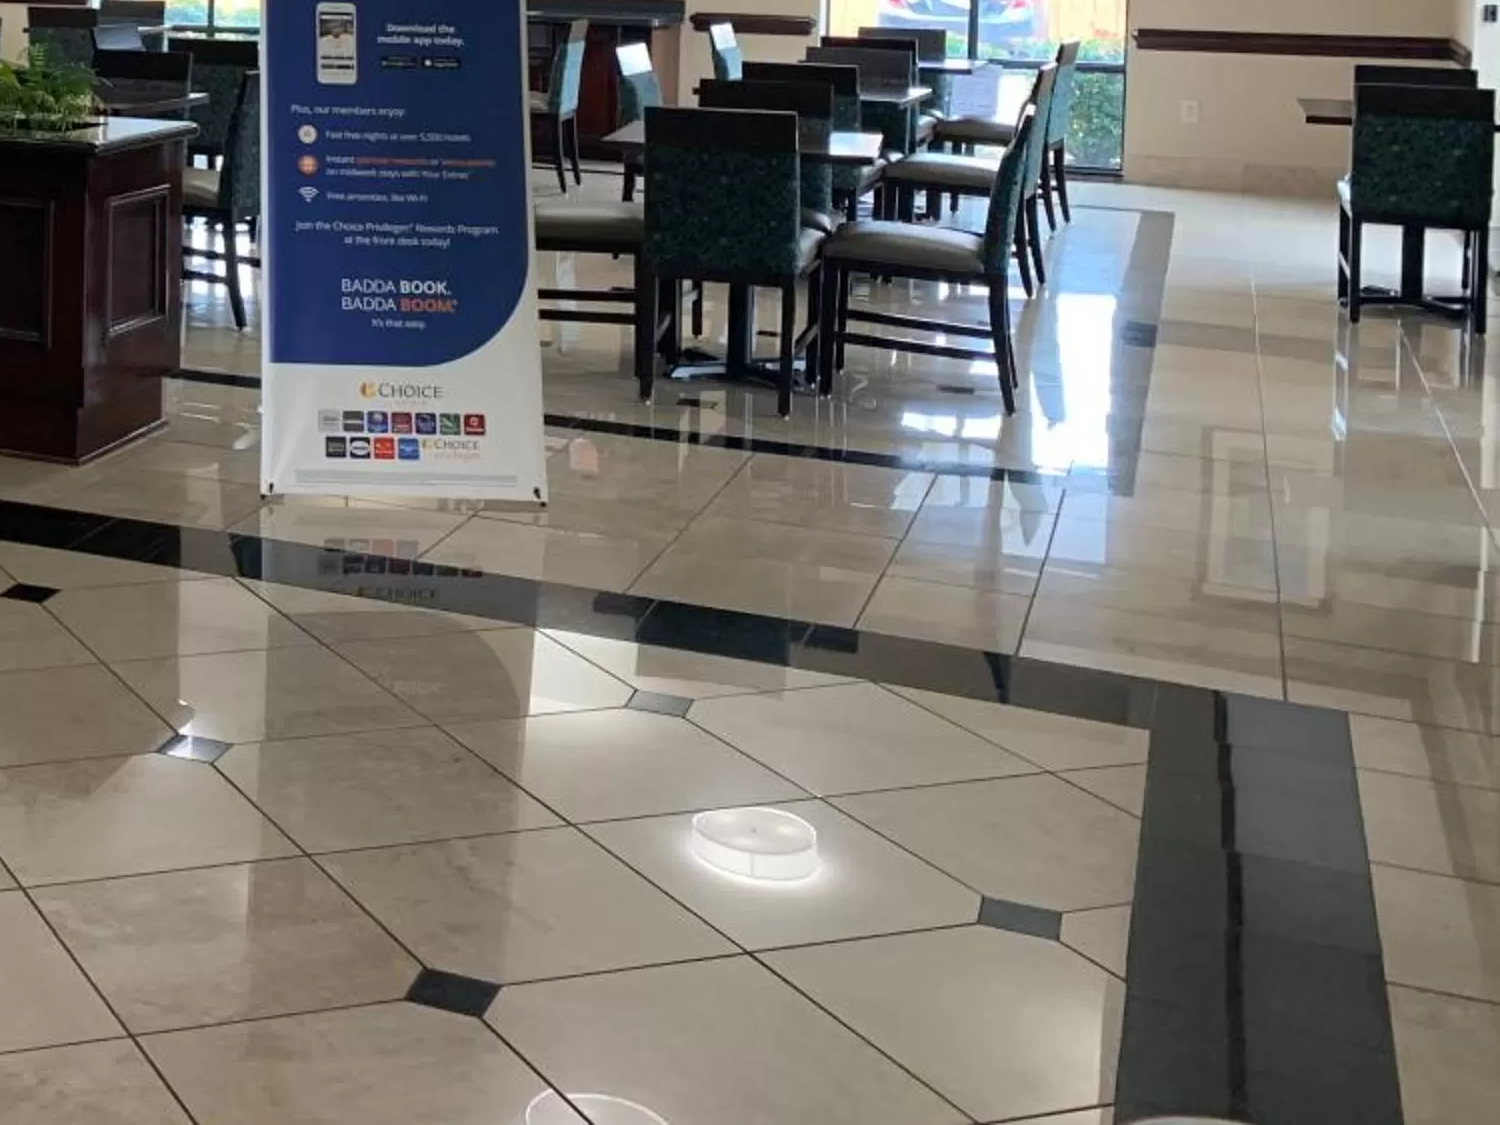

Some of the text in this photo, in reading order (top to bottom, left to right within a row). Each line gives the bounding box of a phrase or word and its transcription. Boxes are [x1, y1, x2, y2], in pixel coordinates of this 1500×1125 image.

[315, 221, 331, 230] the
[332, 221, 365, 231] Choice
[458, 225, 499, 238] Program
[355, 235, 370, 244] the
[341, 278, 396, 293] BADDA
[341, 296, 397, 311] BADDA
[379, 382, 444, 398] CHOICE
[434, 438, 480, 451] CHOICE
